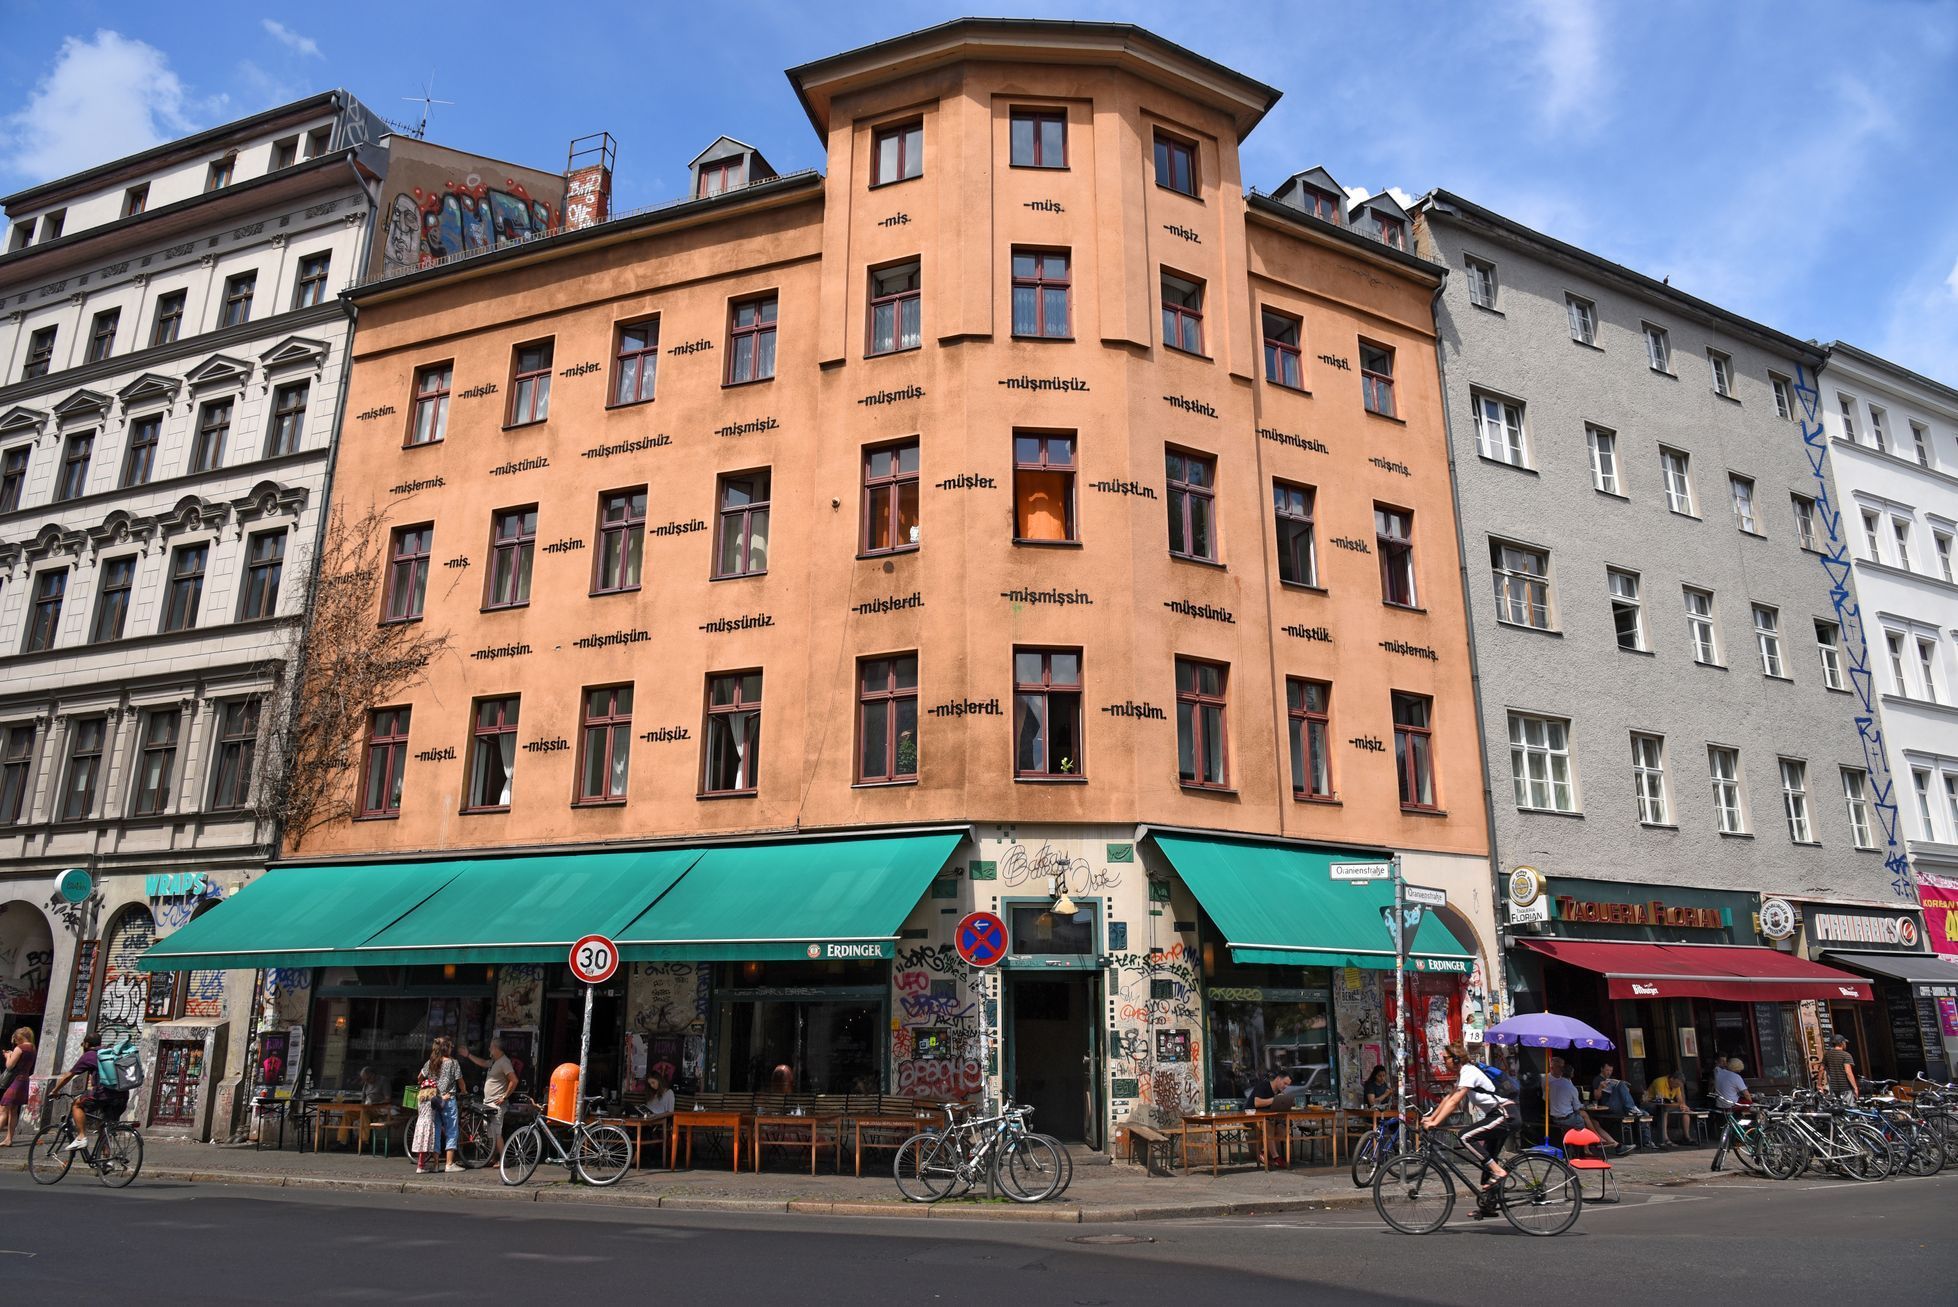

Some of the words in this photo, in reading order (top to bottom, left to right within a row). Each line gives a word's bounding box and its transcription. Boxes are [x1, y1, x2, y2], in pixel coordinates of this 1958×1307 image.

[1336, 865, 1385, 876] Oranienstraße
[145, 872, 208, 896] WRAPS
[1923, 899, 1955, 908] KOREAN
[1511, 912, 1543, 922] FLORIAN
[1561, 896, 1649, 924] TAQUERIA
[1652, 901, 1722, 928] FLORIAN
[827, 944, 883, 958] ERDINGER
[580, 947, 607, 971] 30
[1428, 959, 1467, 972] ERDINGER
[1470, 1032, 1480, 1040] 18
